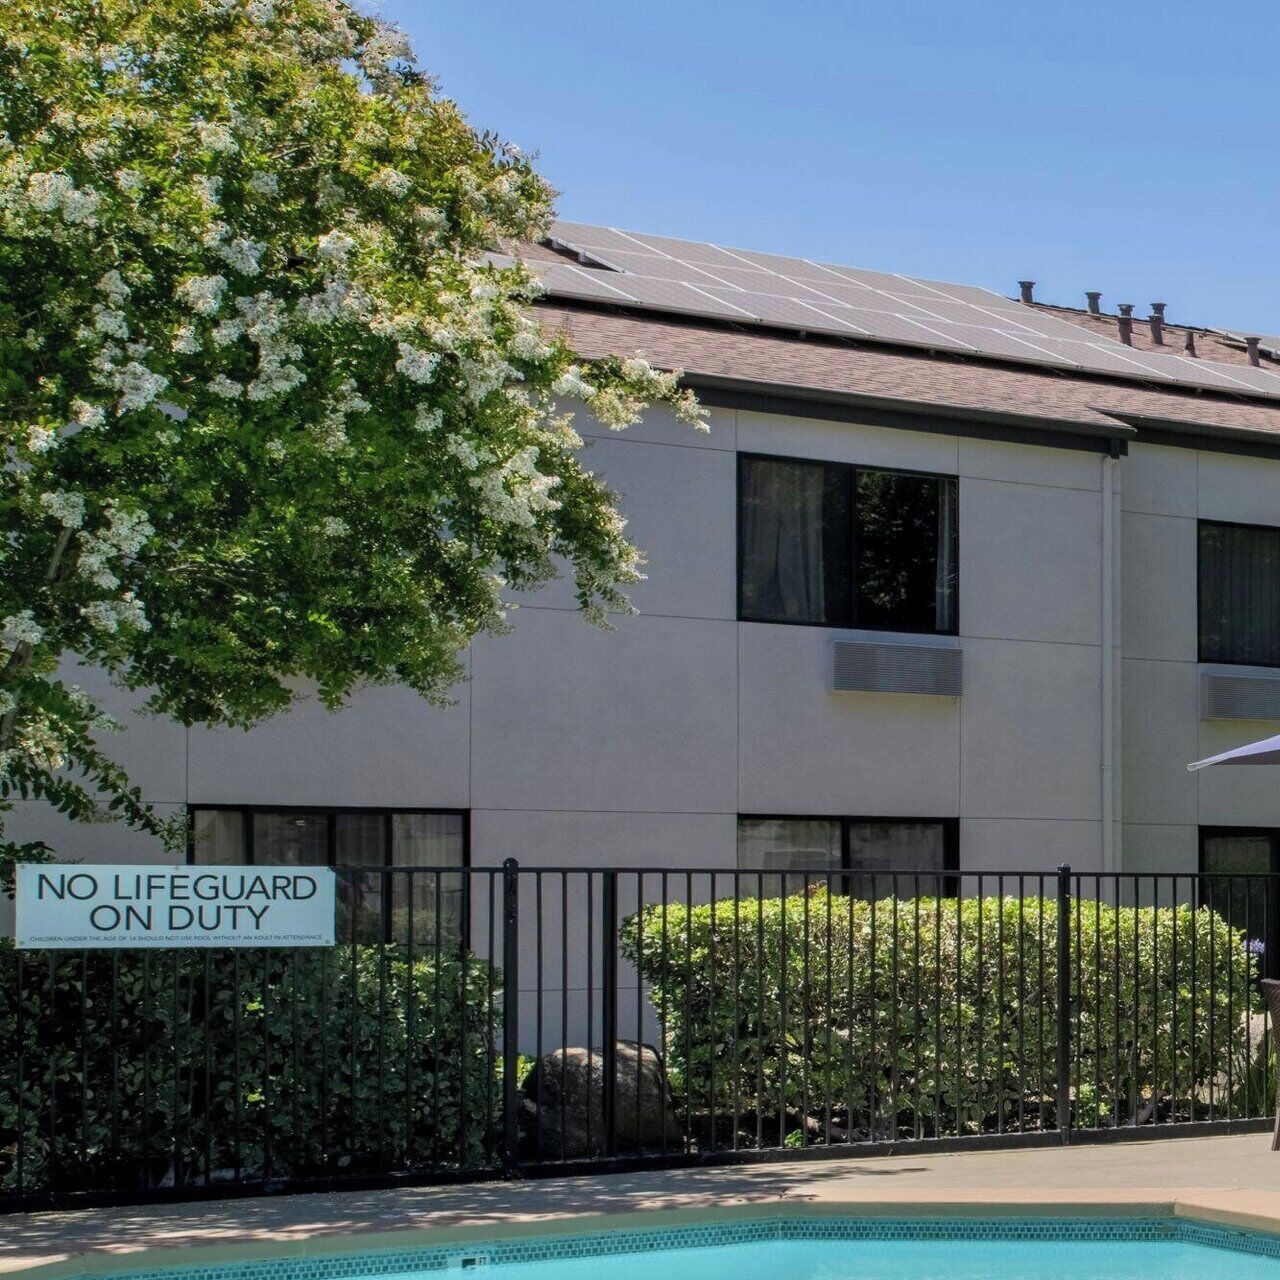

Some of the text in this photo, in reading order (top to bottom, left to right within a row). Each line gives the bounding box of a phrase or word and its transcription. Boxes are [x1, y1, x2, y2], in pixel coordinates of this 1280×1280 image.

[38, 873, 318, 900] NO LIFEGUARD
[90, 904, 270, 931] ON DUTY
